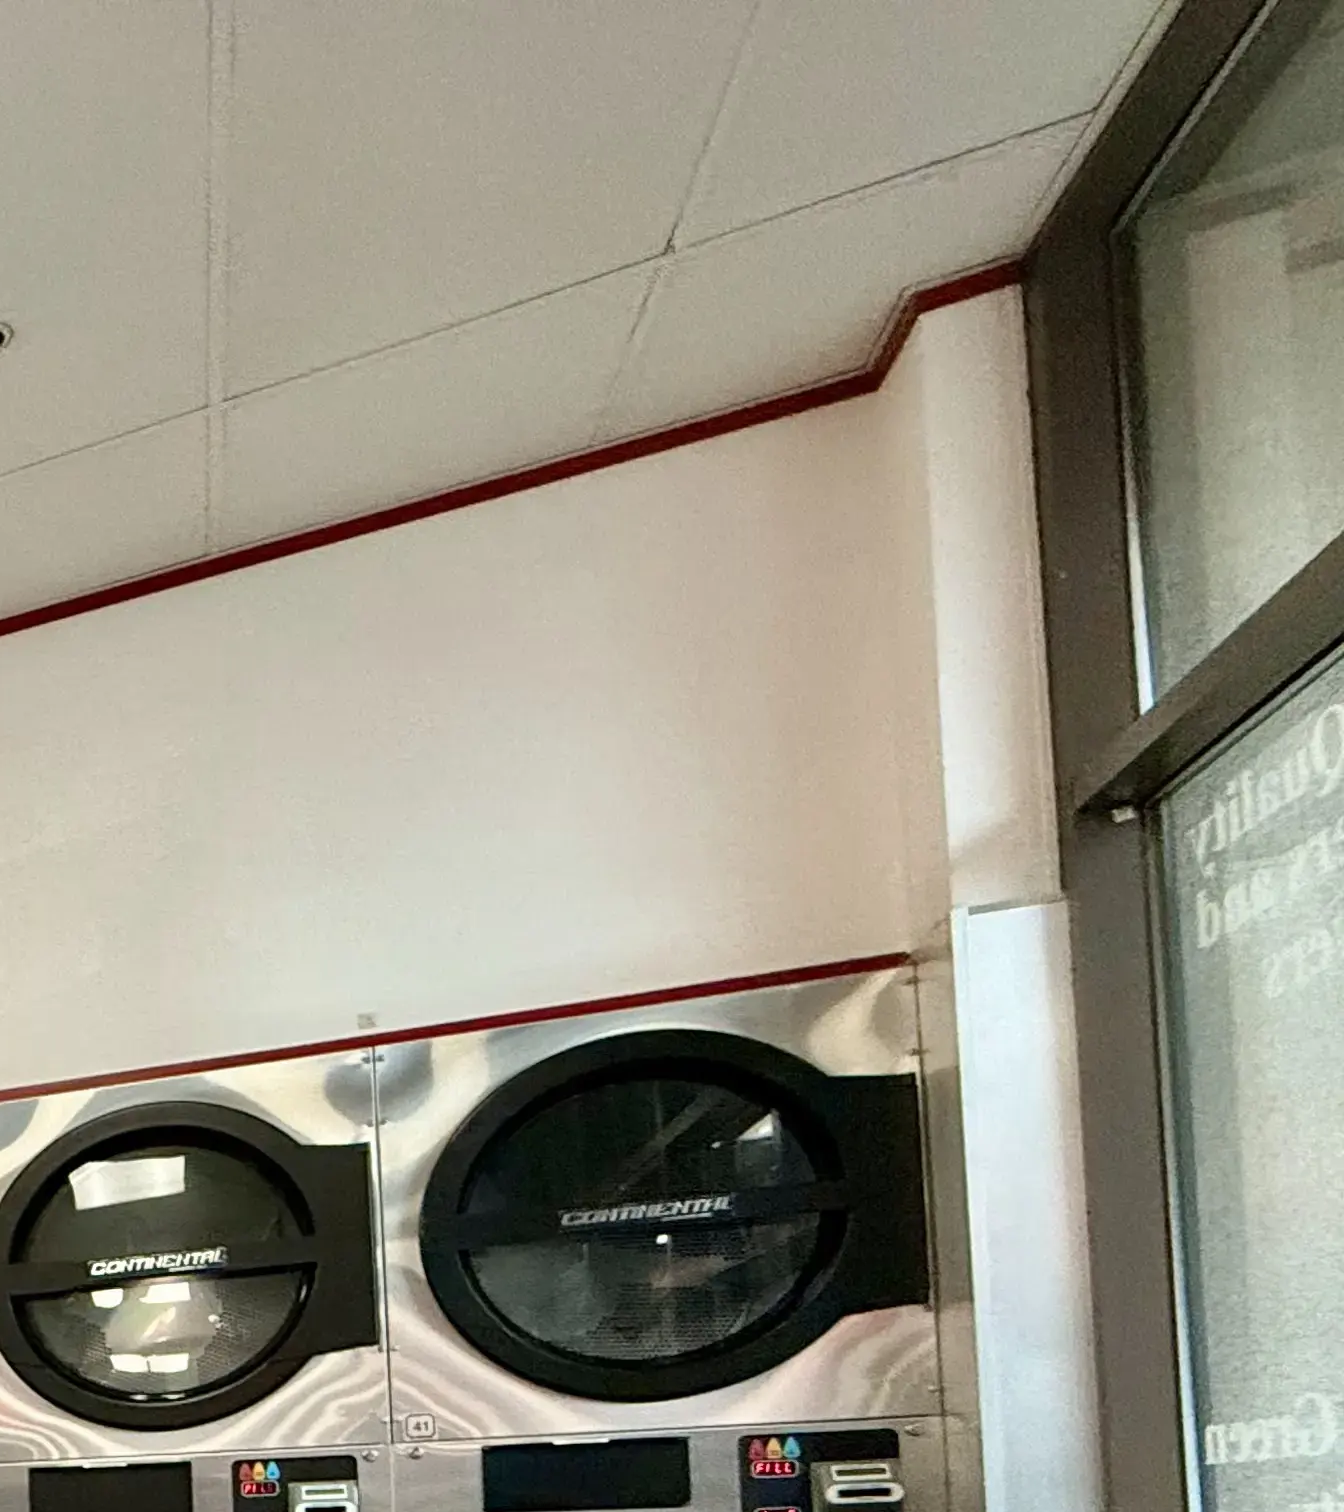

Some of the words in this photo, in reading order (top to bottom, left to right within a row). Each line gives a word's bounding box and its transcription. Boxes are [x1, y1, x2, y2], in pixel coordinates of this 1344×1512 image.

[561, 1195, 731, 1226] CONTINENTAL
[90, 1248, 226, 1277] CONTINENTAL
[755, 1462, 793, 1474] FILL
